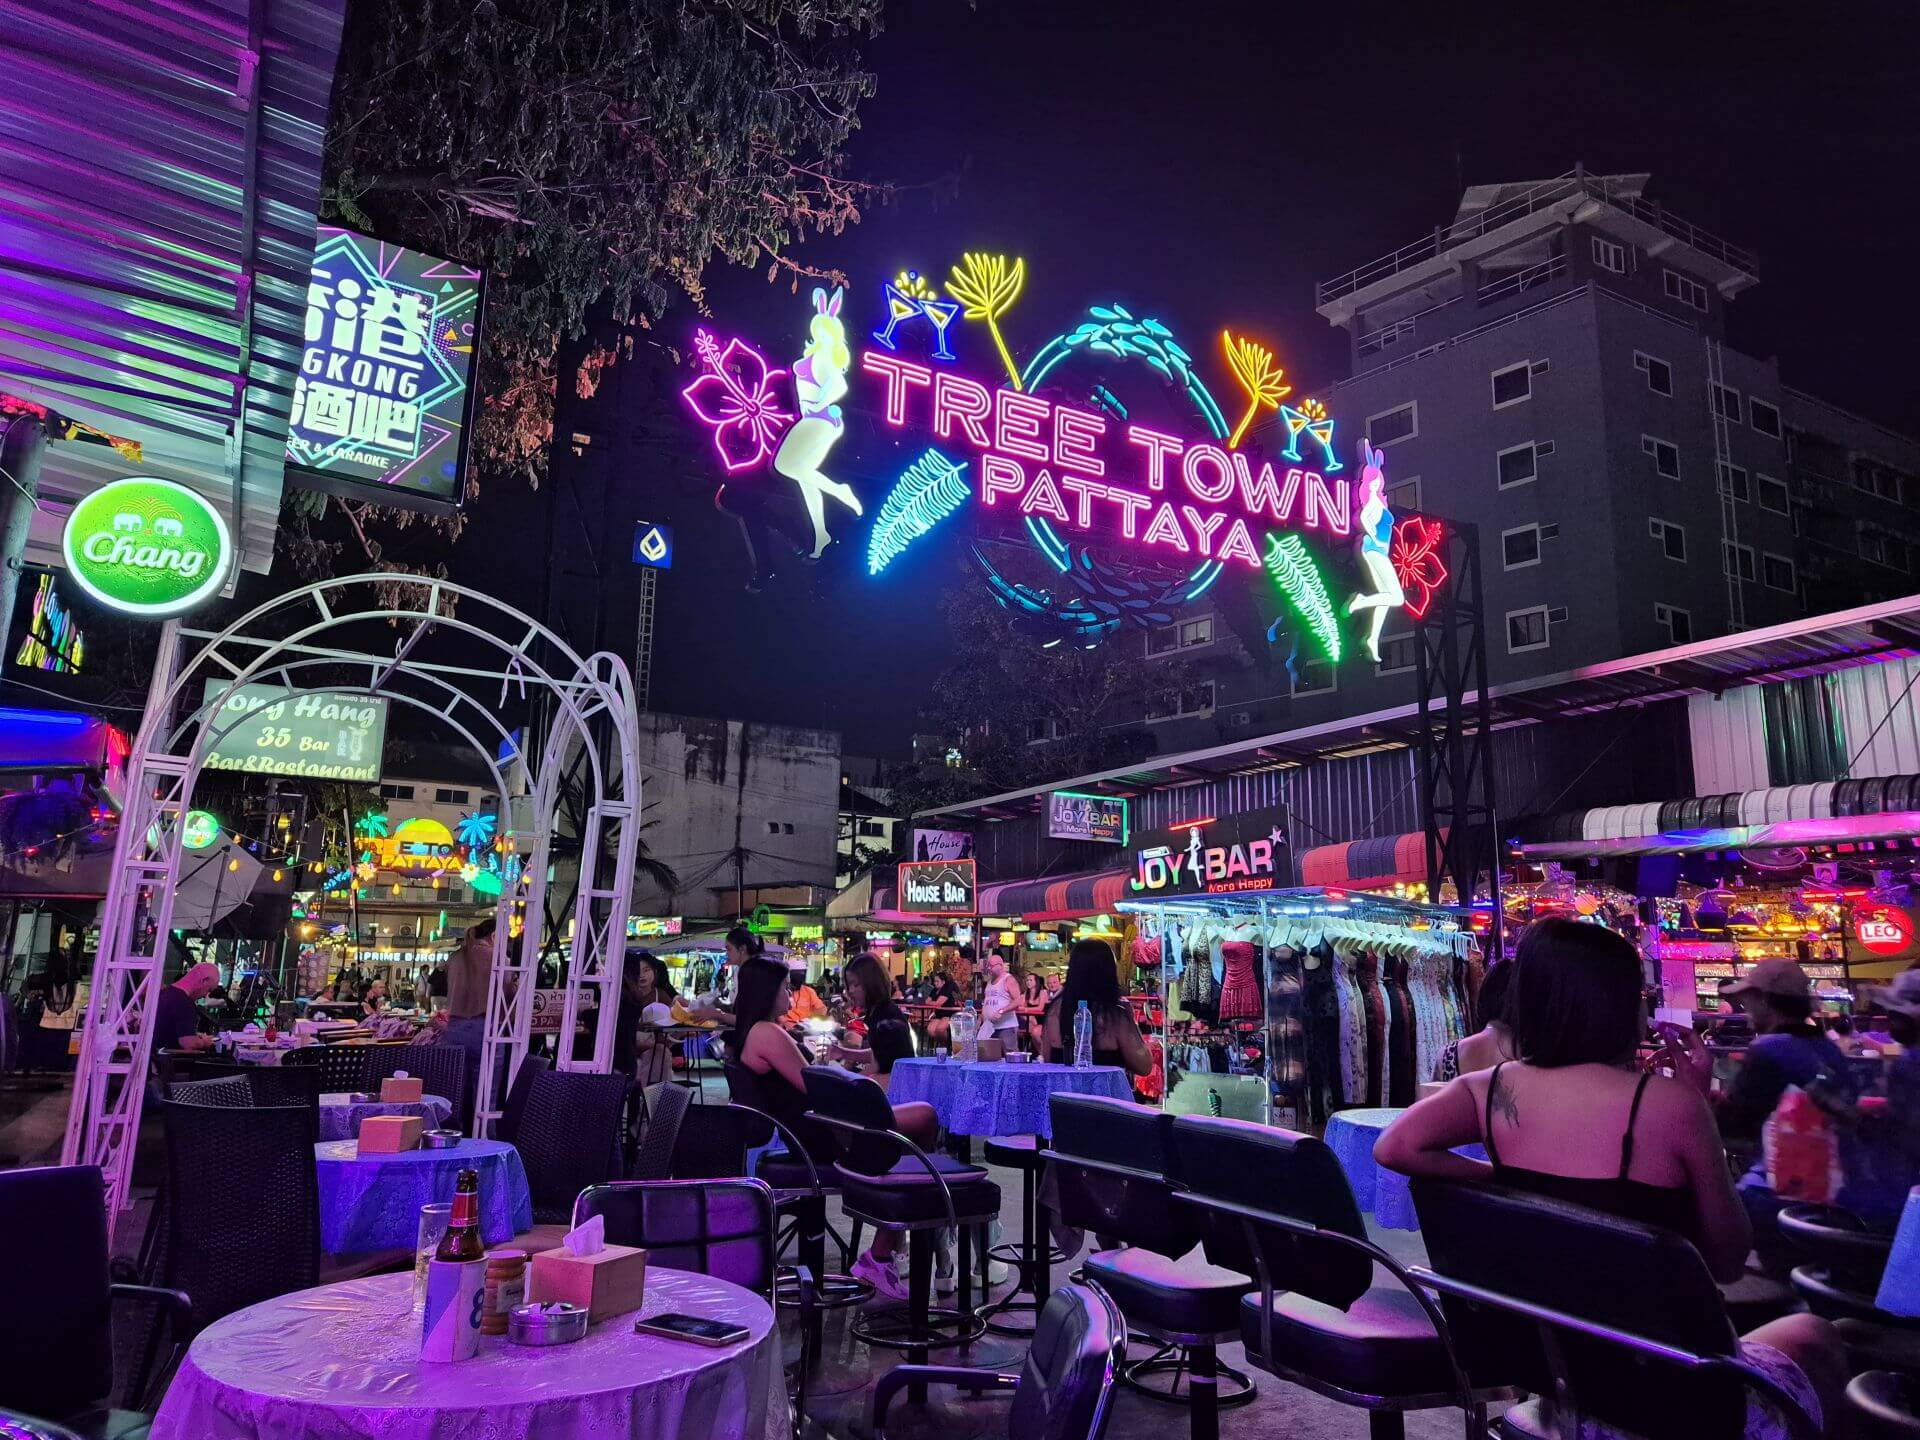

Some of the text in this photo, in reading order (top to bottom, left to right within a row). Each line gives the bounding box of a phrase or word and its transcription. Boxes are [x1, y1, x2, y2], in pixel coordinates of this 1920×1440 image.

[863, 351, 1351, 535] TREE TOWN
[326, 447, 391, 469] KARAOKE
[980, 454, 1262, 567] PATTAYA
[83, 531, 206, 578] Chang
[294, 695, 377, 728] Hang
[256, 726, 292, 748] 35
[299, 736, 330, 752] Bar
[203, 751, 376, 780] Bar&Restaurant
[1054, 807, 1121, 827] JOY BAR
[928, 833, 961, 851] House
[382, 854, 462, 870] PATTAYA
[1131, 839, 1273, 891] JOY BAR
[907, 879, 966, 903] HOUSE BAR
[1863, 924, 1898, 938] LEO
[364, 951, 401, 961] PRIME
